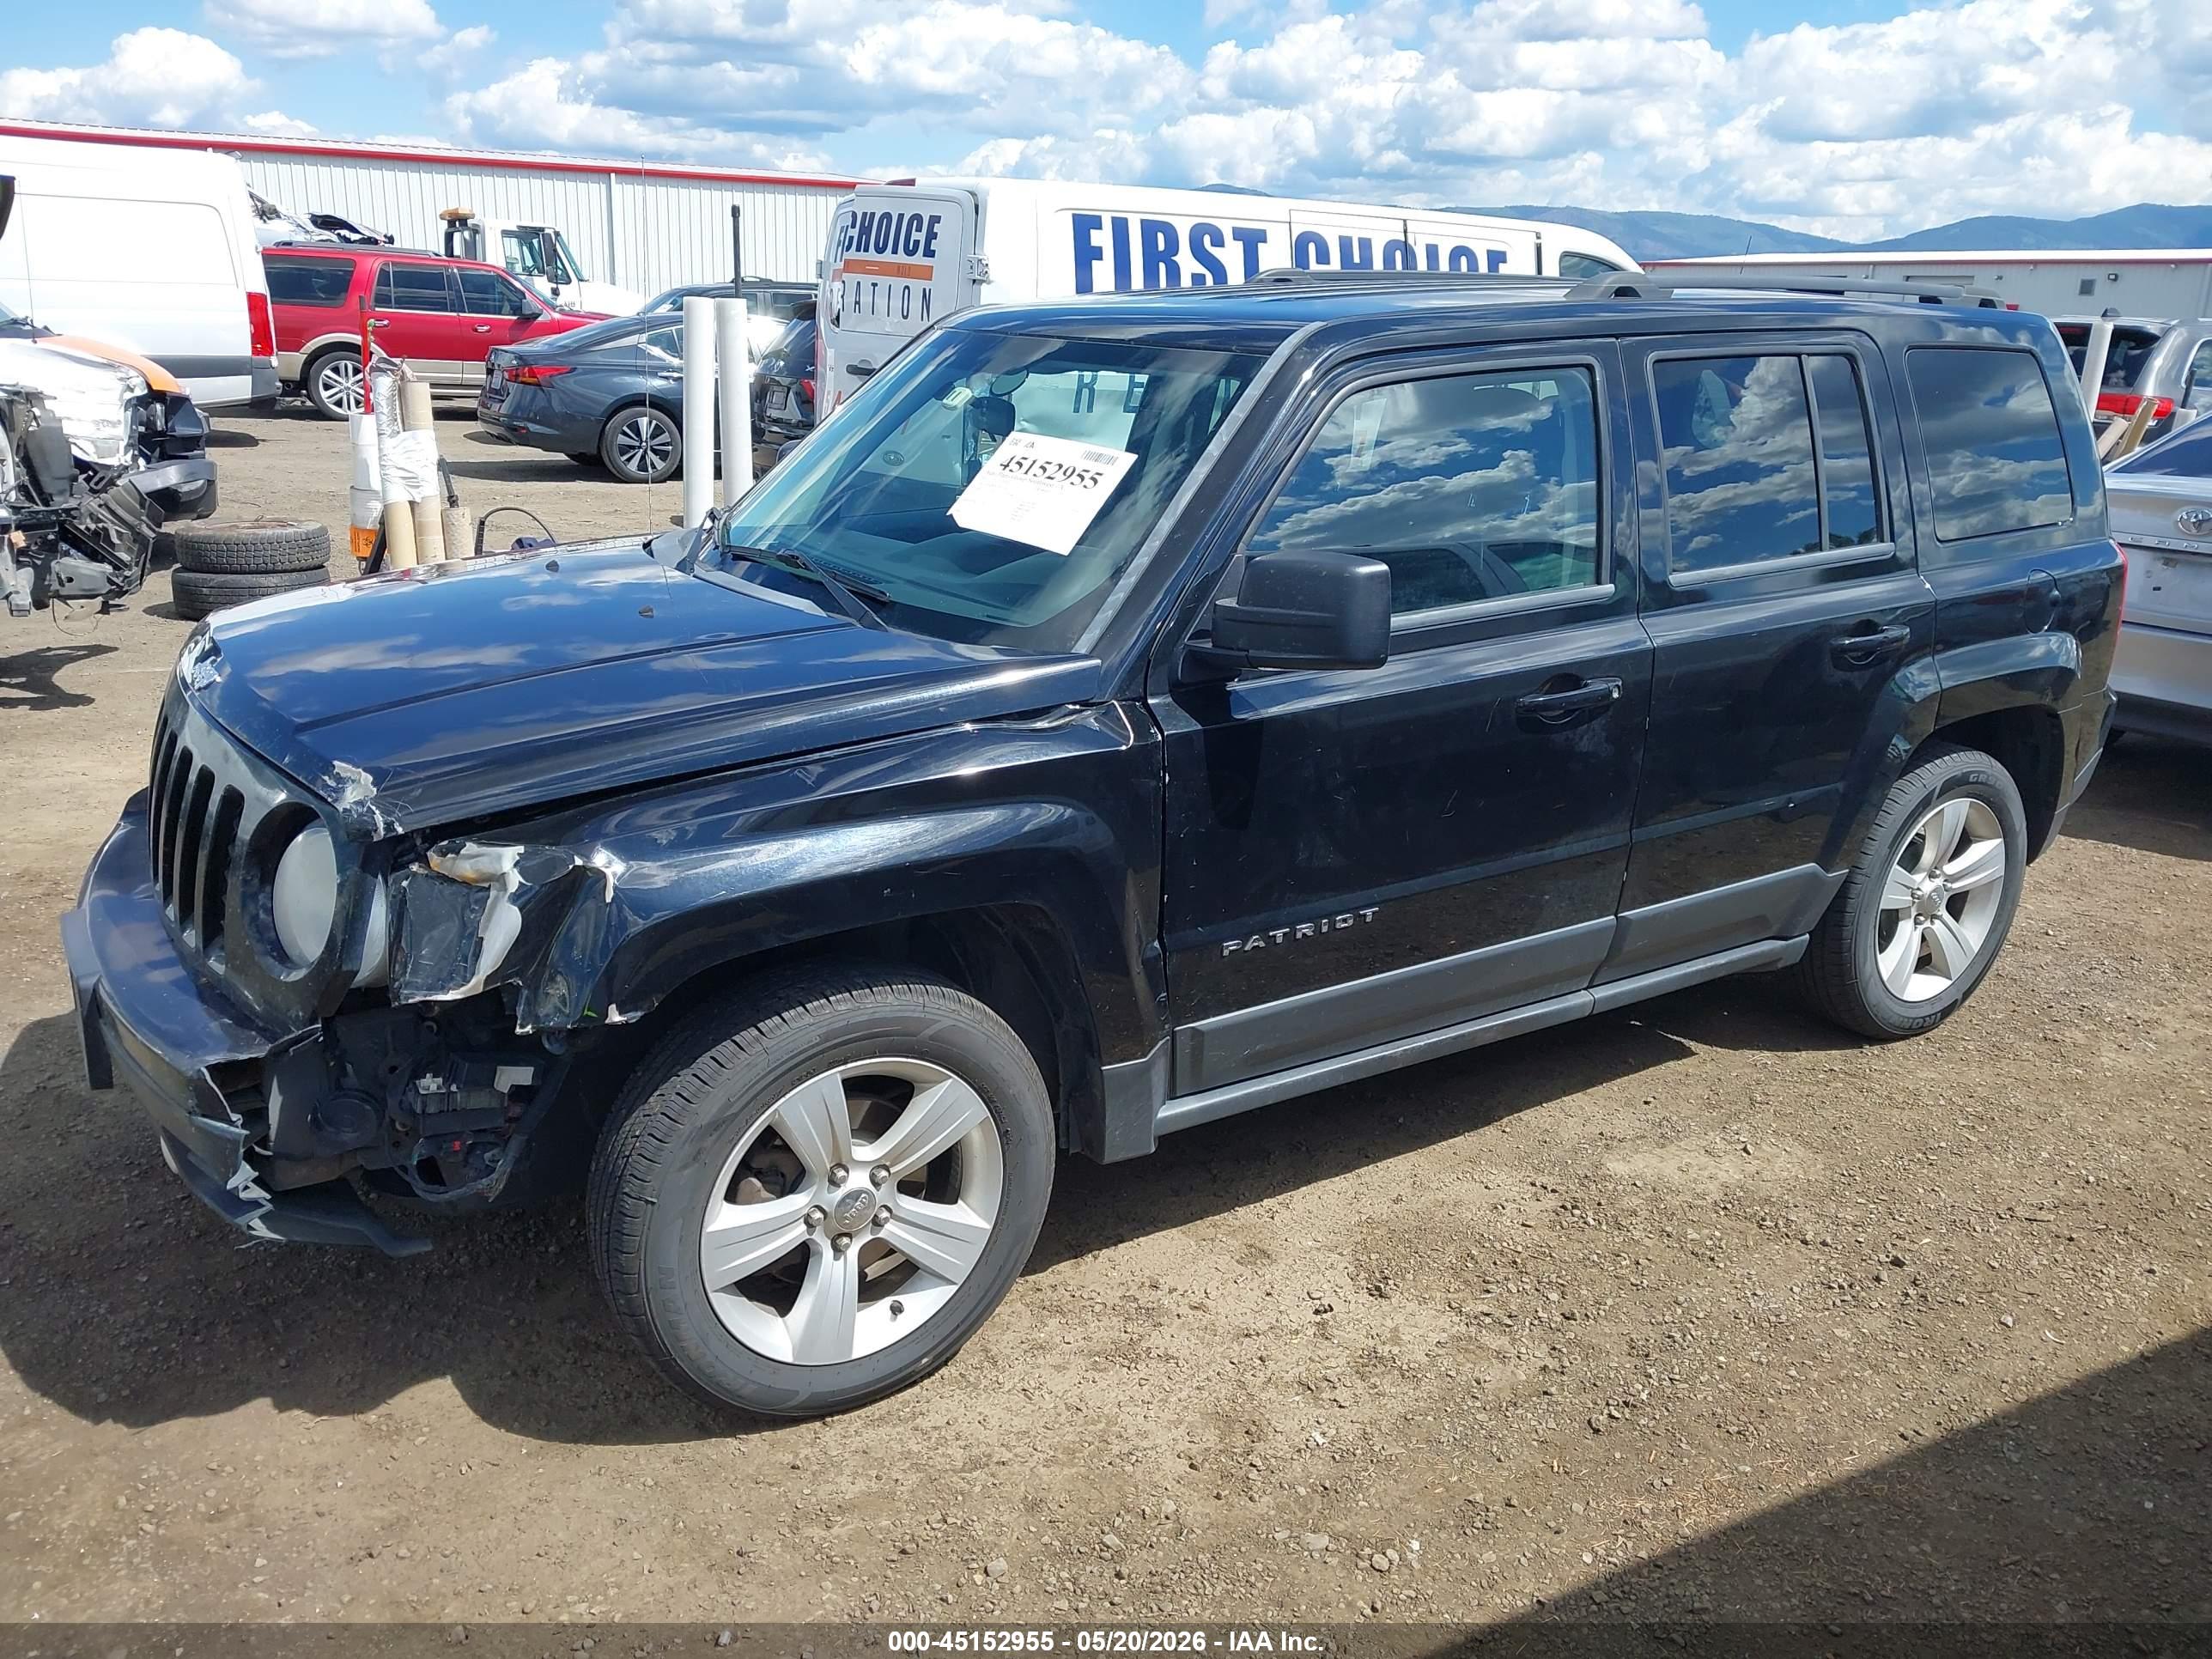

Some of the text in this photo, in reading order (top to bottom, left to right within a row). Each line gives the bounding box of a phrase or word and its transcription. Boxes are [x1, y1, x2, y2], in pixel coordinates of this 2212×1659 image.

[1072, 213, 1267, 294] FIRST
[1000, 454, 1104, 489] 45152955
[1222, 907, 1380, 957] PATRIOT
